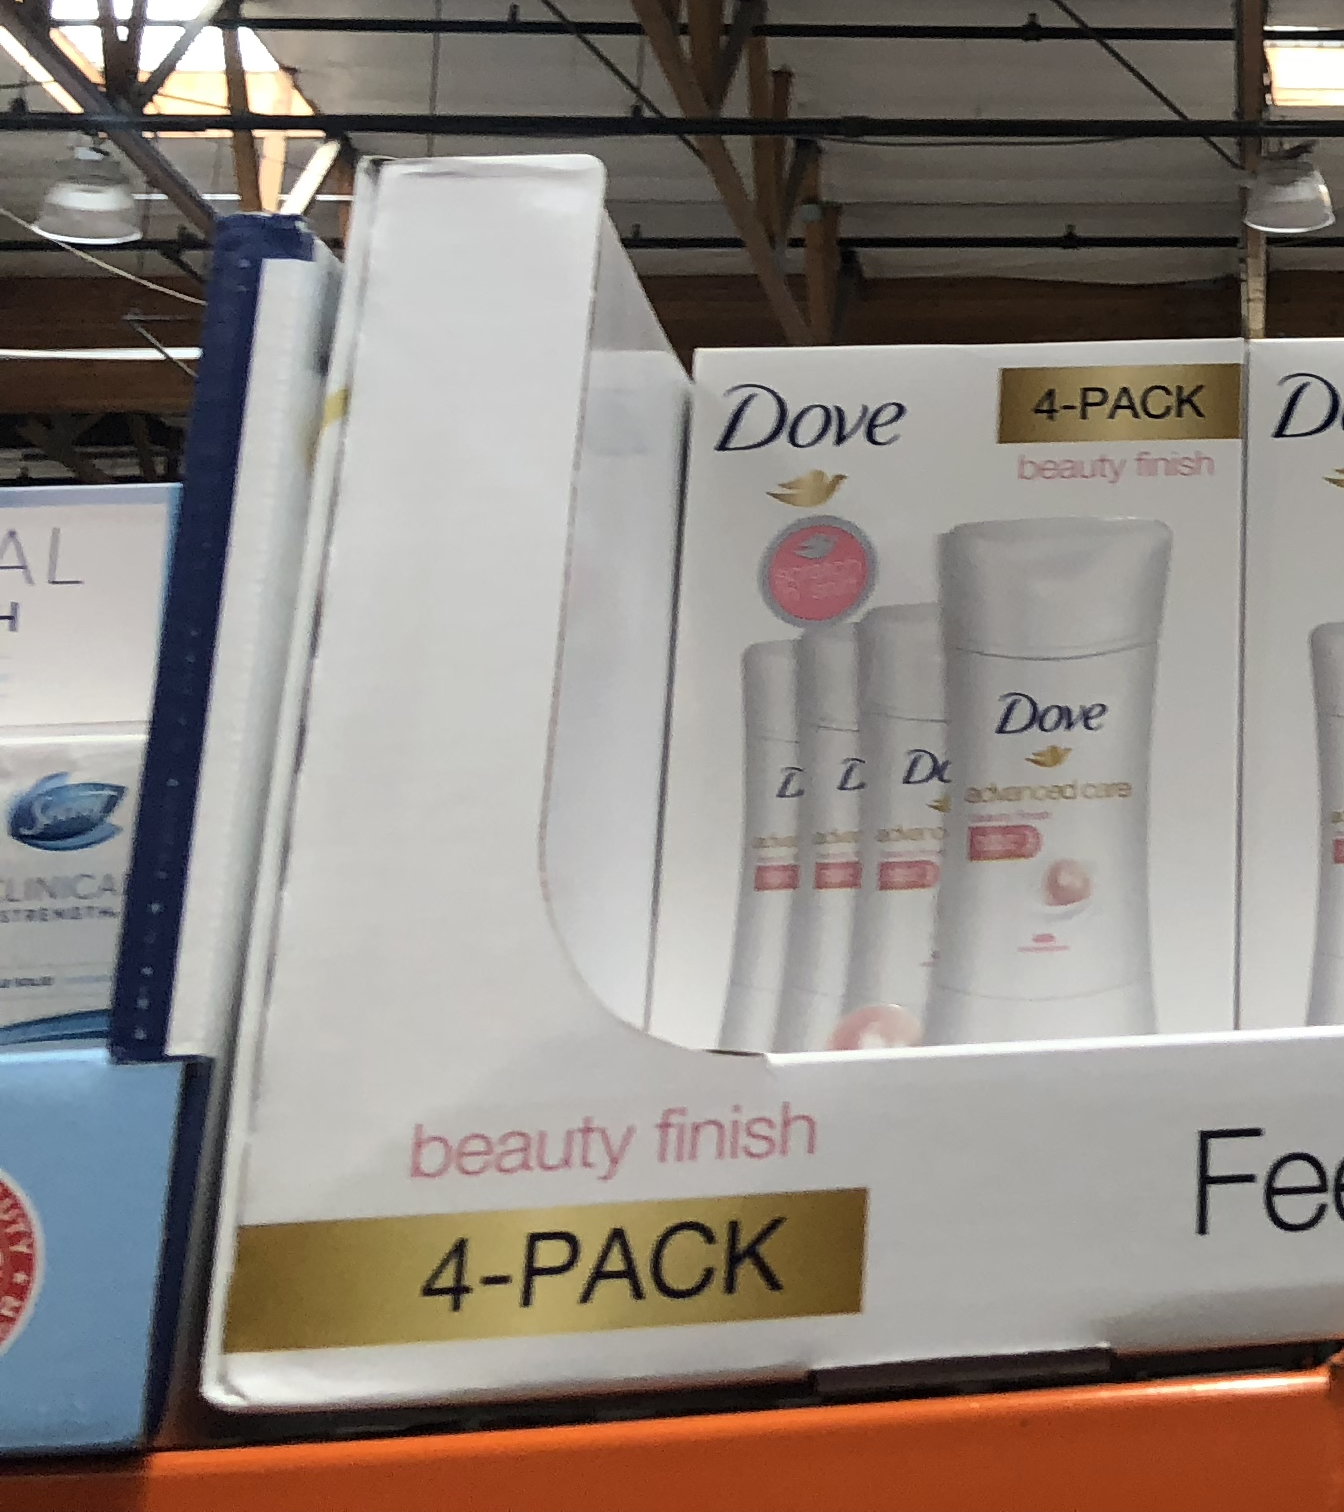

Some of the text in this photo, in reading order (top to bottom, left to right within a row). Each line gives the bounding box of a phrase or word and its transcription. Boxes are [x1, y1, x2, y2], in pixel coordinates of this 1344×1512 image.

[714, 383, 907, 452] Dove
[1033, 384, 1207, 422] 4-PACK
[1016, 449, 1217, 485] beauty finish
[995, 692, 1109, 735] Dove
[409, 1101, 818, 1182] beauty finish
[420, 1216, 788, 1313] 4-PACK
